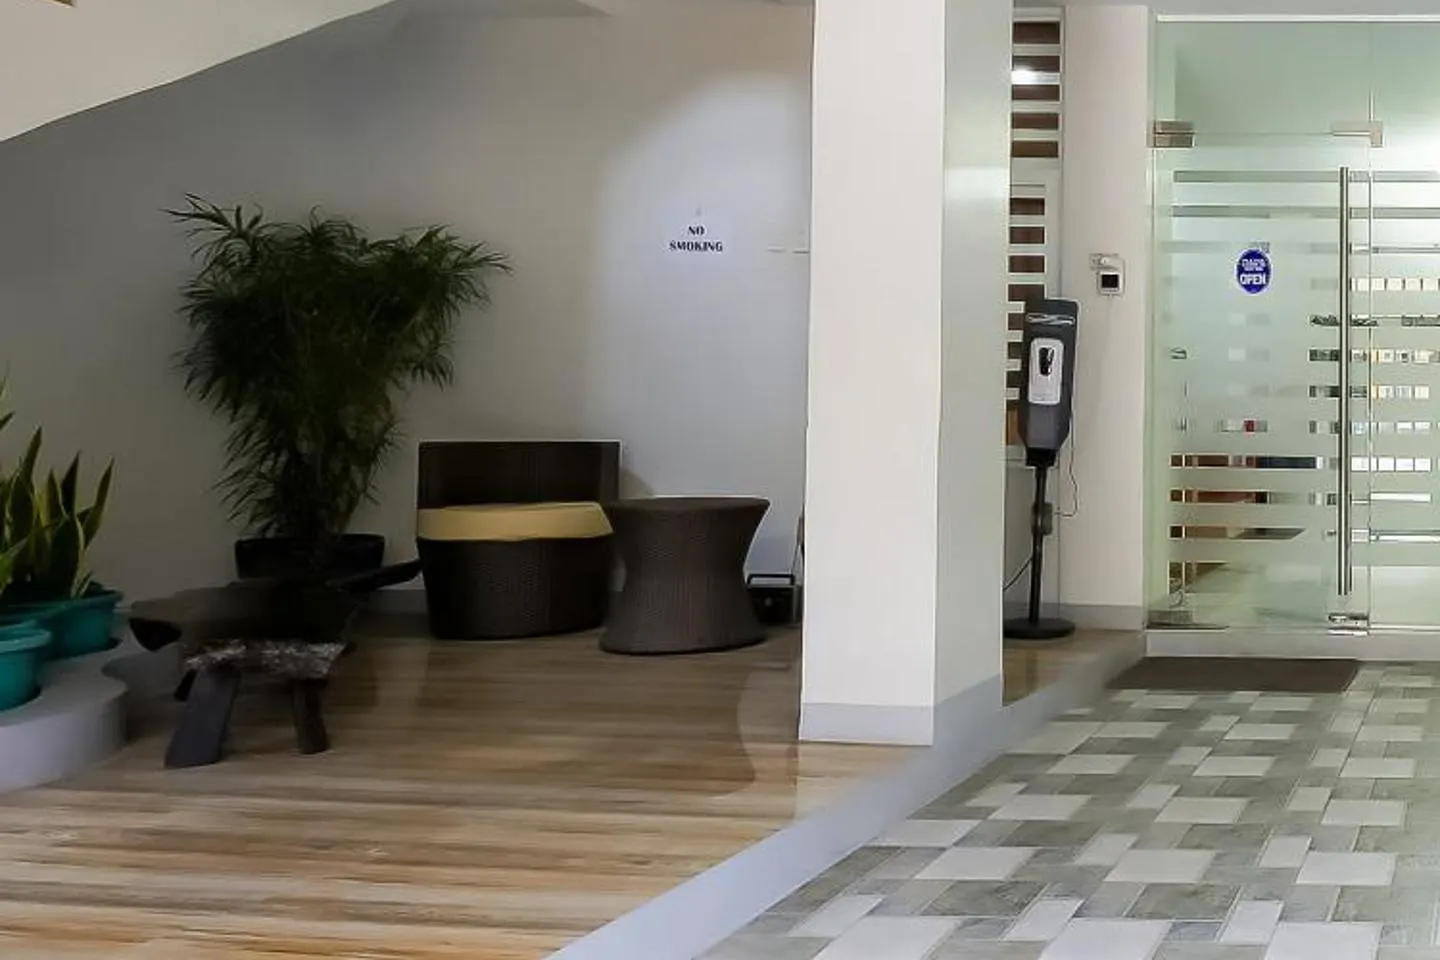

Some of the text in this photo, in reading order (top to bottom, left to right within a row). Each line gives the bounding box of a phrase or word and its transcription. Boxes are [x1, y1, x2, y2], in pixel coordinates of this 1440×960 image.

[688, 226, 706, 236] NO
[669, 240, 724, 253] SMOKING
[1240, 273, 1266, 285] OPEN
